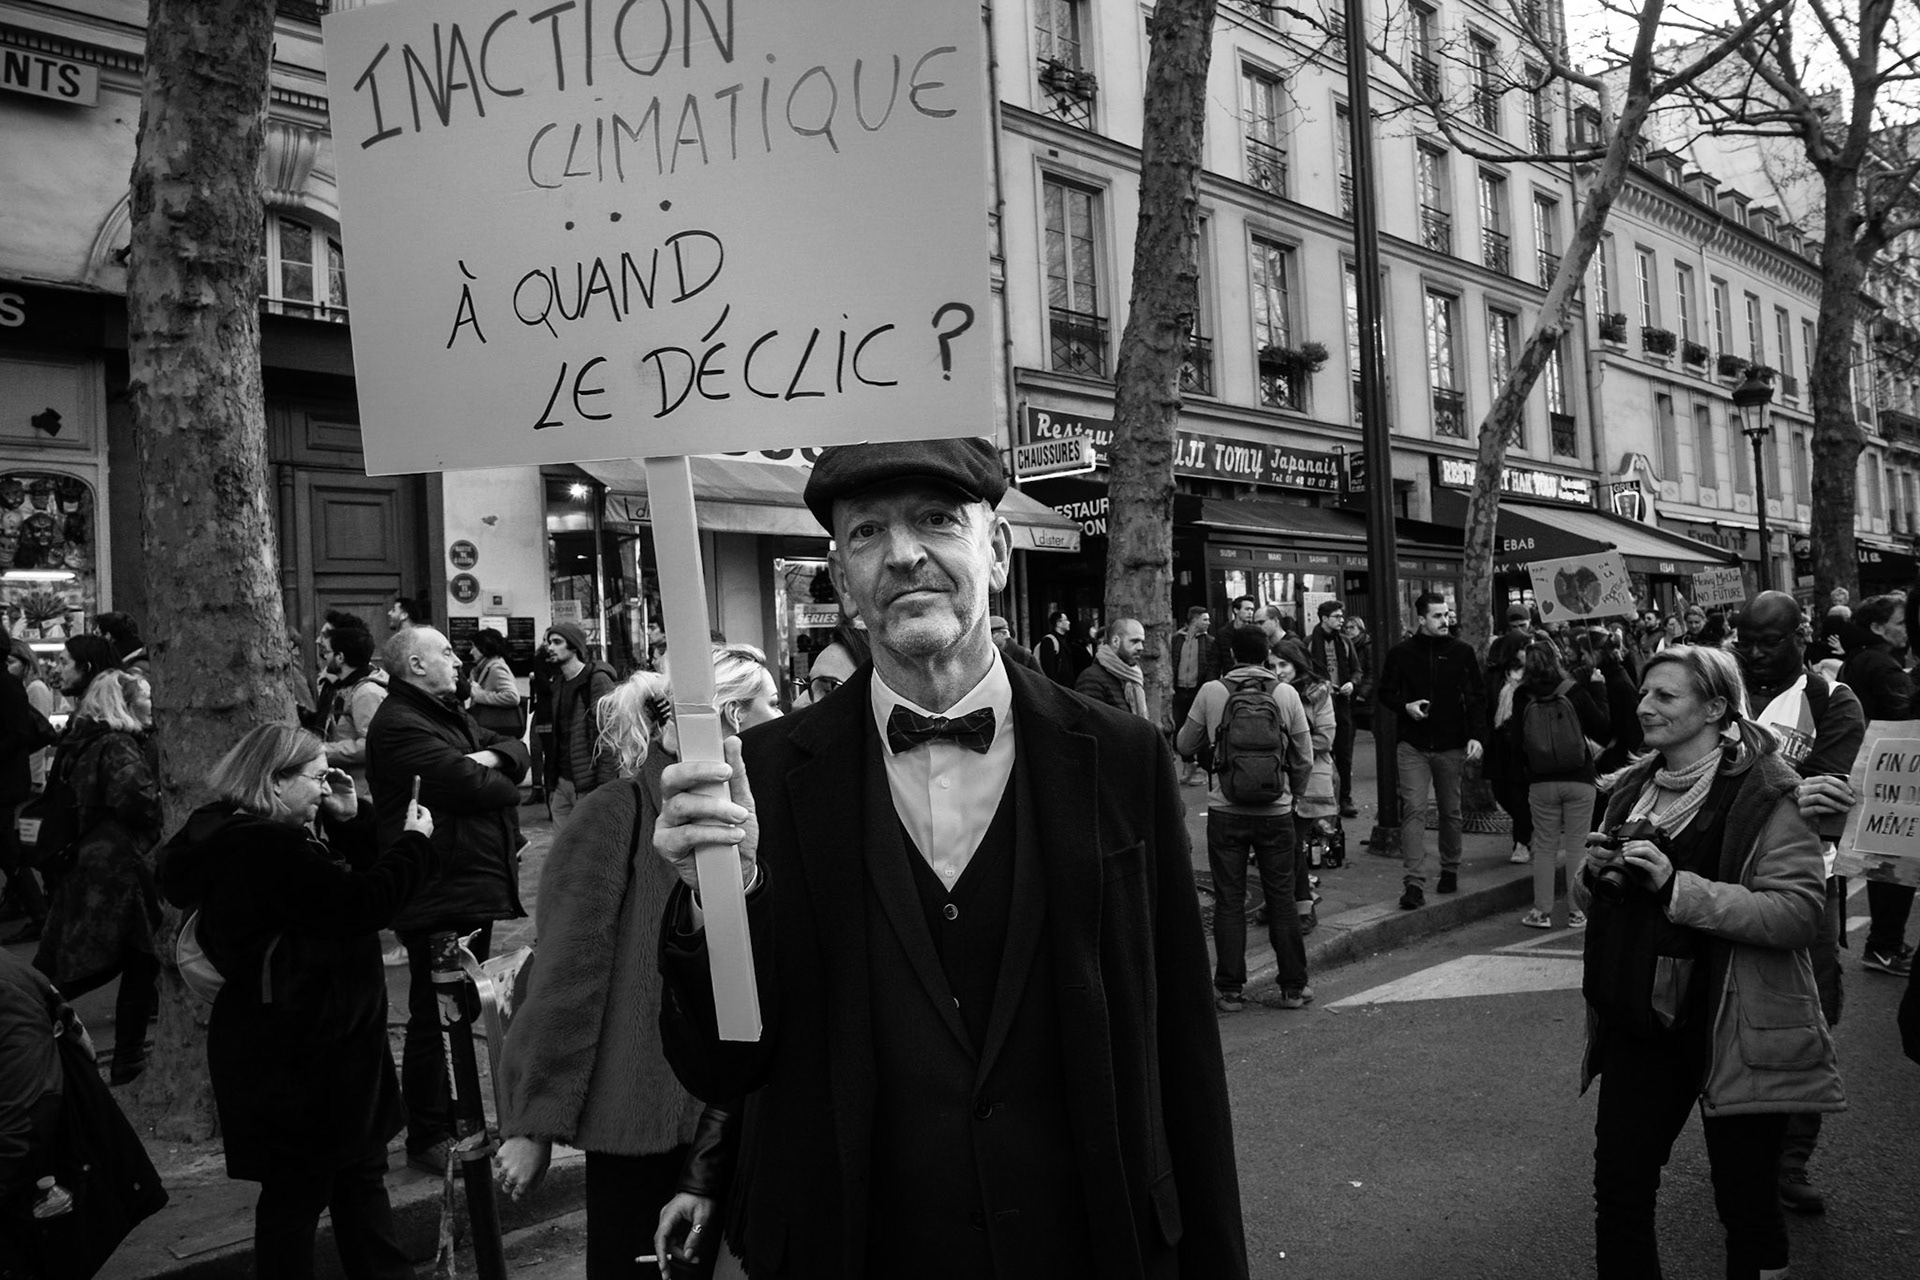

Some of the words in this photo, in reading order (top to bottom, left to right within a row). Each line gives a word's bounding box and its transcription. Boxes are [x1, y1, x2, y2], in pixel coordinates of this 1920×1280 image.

[353, 0, 734, 150] INACTION
[527, 46, 958, 190] CLIMATIQUE
[446, 258, 487, 350] À
[512, 229, 725, 339] QUAND
[533, 356, 612, 430] LE
[642, 303, 899, 419] DÉCLIC
[1017, 440, 1080, 470] CHAUSSURES
[1270, 448, 1339, 476] Japonais
[1613, 482, 1640, 493] GRILL
[1049, 497, 1110, 519] ESTAUR
[1494, 564, 1510, 573] AK
[1697, 591, 1710, 602] NO
[1713, 587, 1744, 601] FUTURE
[1876, 752, 1906, 773] FIN
[1875, 783, 1901, 804] FIN
[1865, 811, 1920, 838] MÊME
